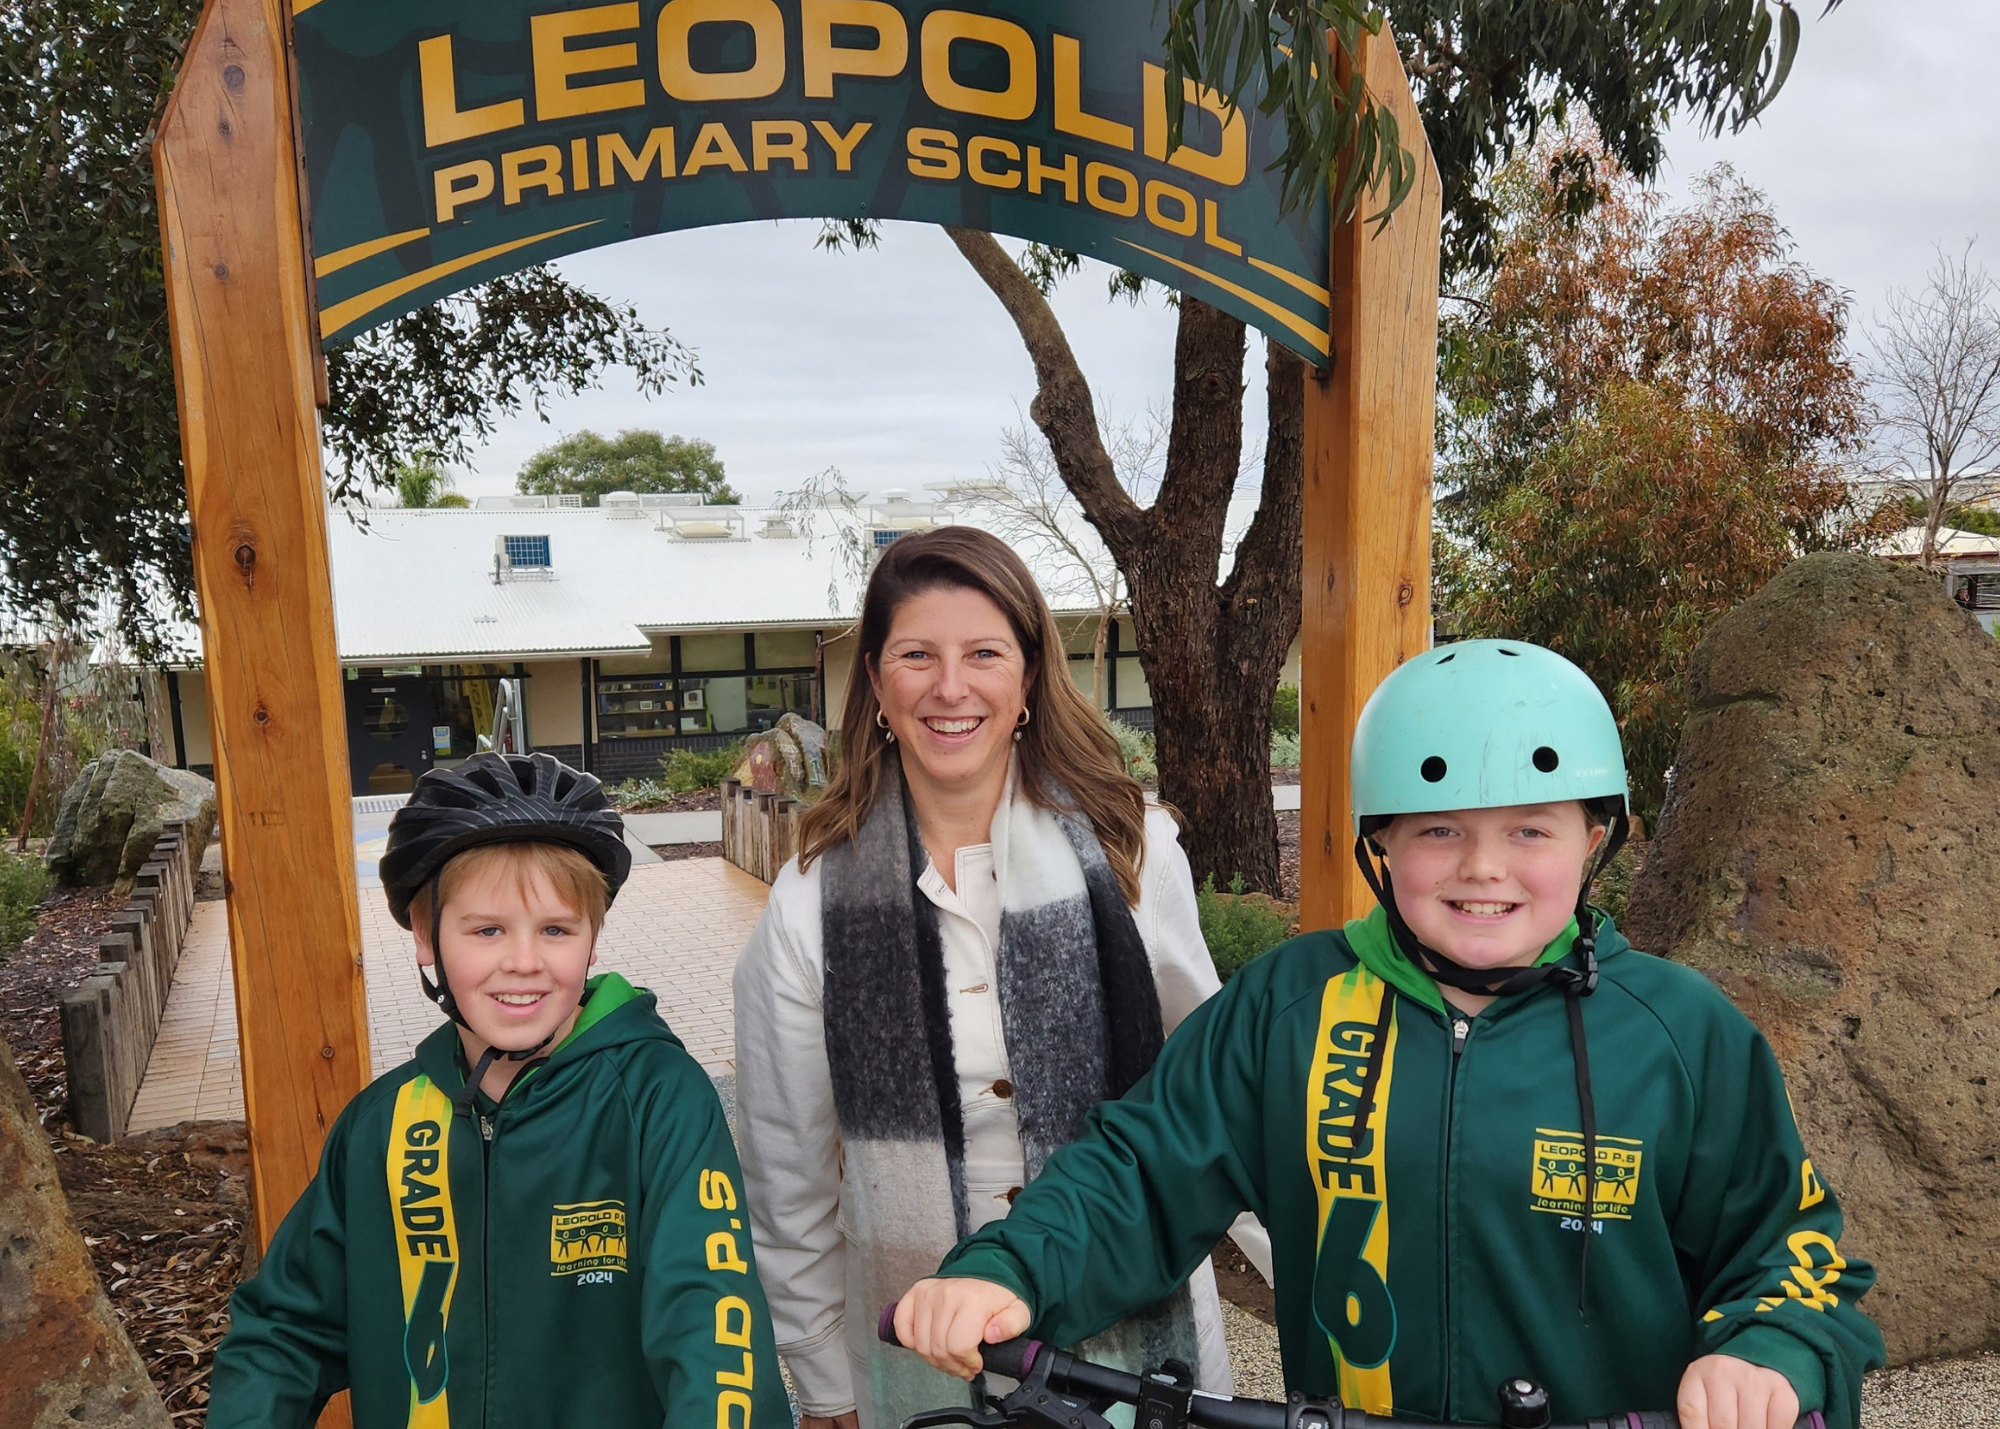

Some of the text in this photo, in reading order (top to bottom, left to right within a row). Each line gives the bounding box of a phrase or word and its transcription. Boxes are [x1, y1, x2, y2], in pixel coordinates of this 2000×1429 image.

[418, 0, 1247, 186] LEOPOLD
[433, 119, 1243, 257] PRIMARY SCHOOL
[1317, 1021, 1377, 1196] GRADE
[1541, 1144, 1608, 1160] LEOPOD
[400, 1120, 452, 1258] GRADE
[1593, 1202, 1608, 1213] for
[1609, 1203, 1629, 1214] life
[556, 1212, 611, 1226] LEOPOLD
[1560, 1216, 1604, 1235] 204
[557, 1259, 599, 1272] learning
[603, 1257, 616, 1265] for
[577, 1271, 613, 1286] 2024
[1312, 1196, 1398, 1371] 6
